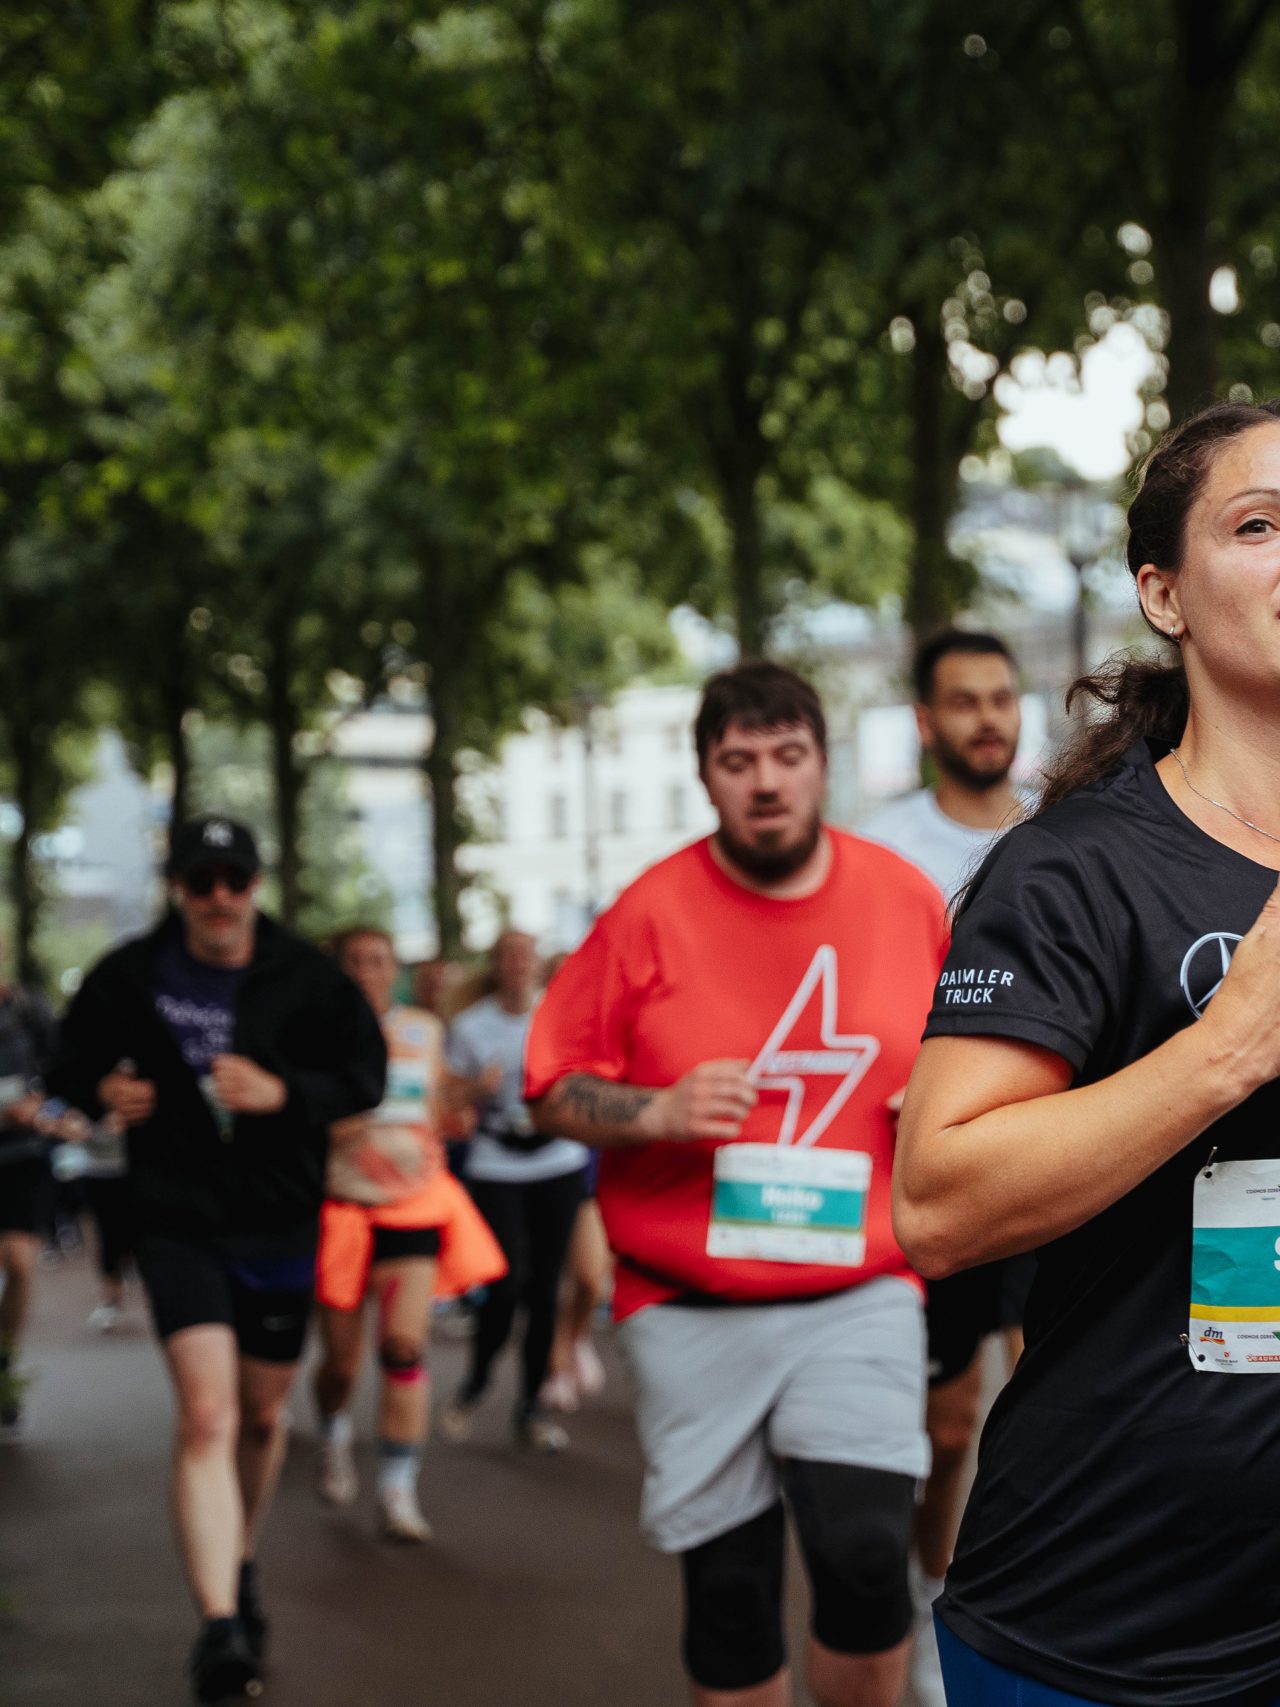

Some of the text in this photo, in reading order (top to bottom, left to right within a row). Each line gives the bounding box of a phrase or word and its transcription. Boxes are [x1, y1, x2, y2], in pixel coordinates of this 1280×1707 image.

[940, 968, 1015, 988] DAIMLER
[945, 987, 994, 1005] TRUCK
[1203, 1326, 1223, 1339] dm
